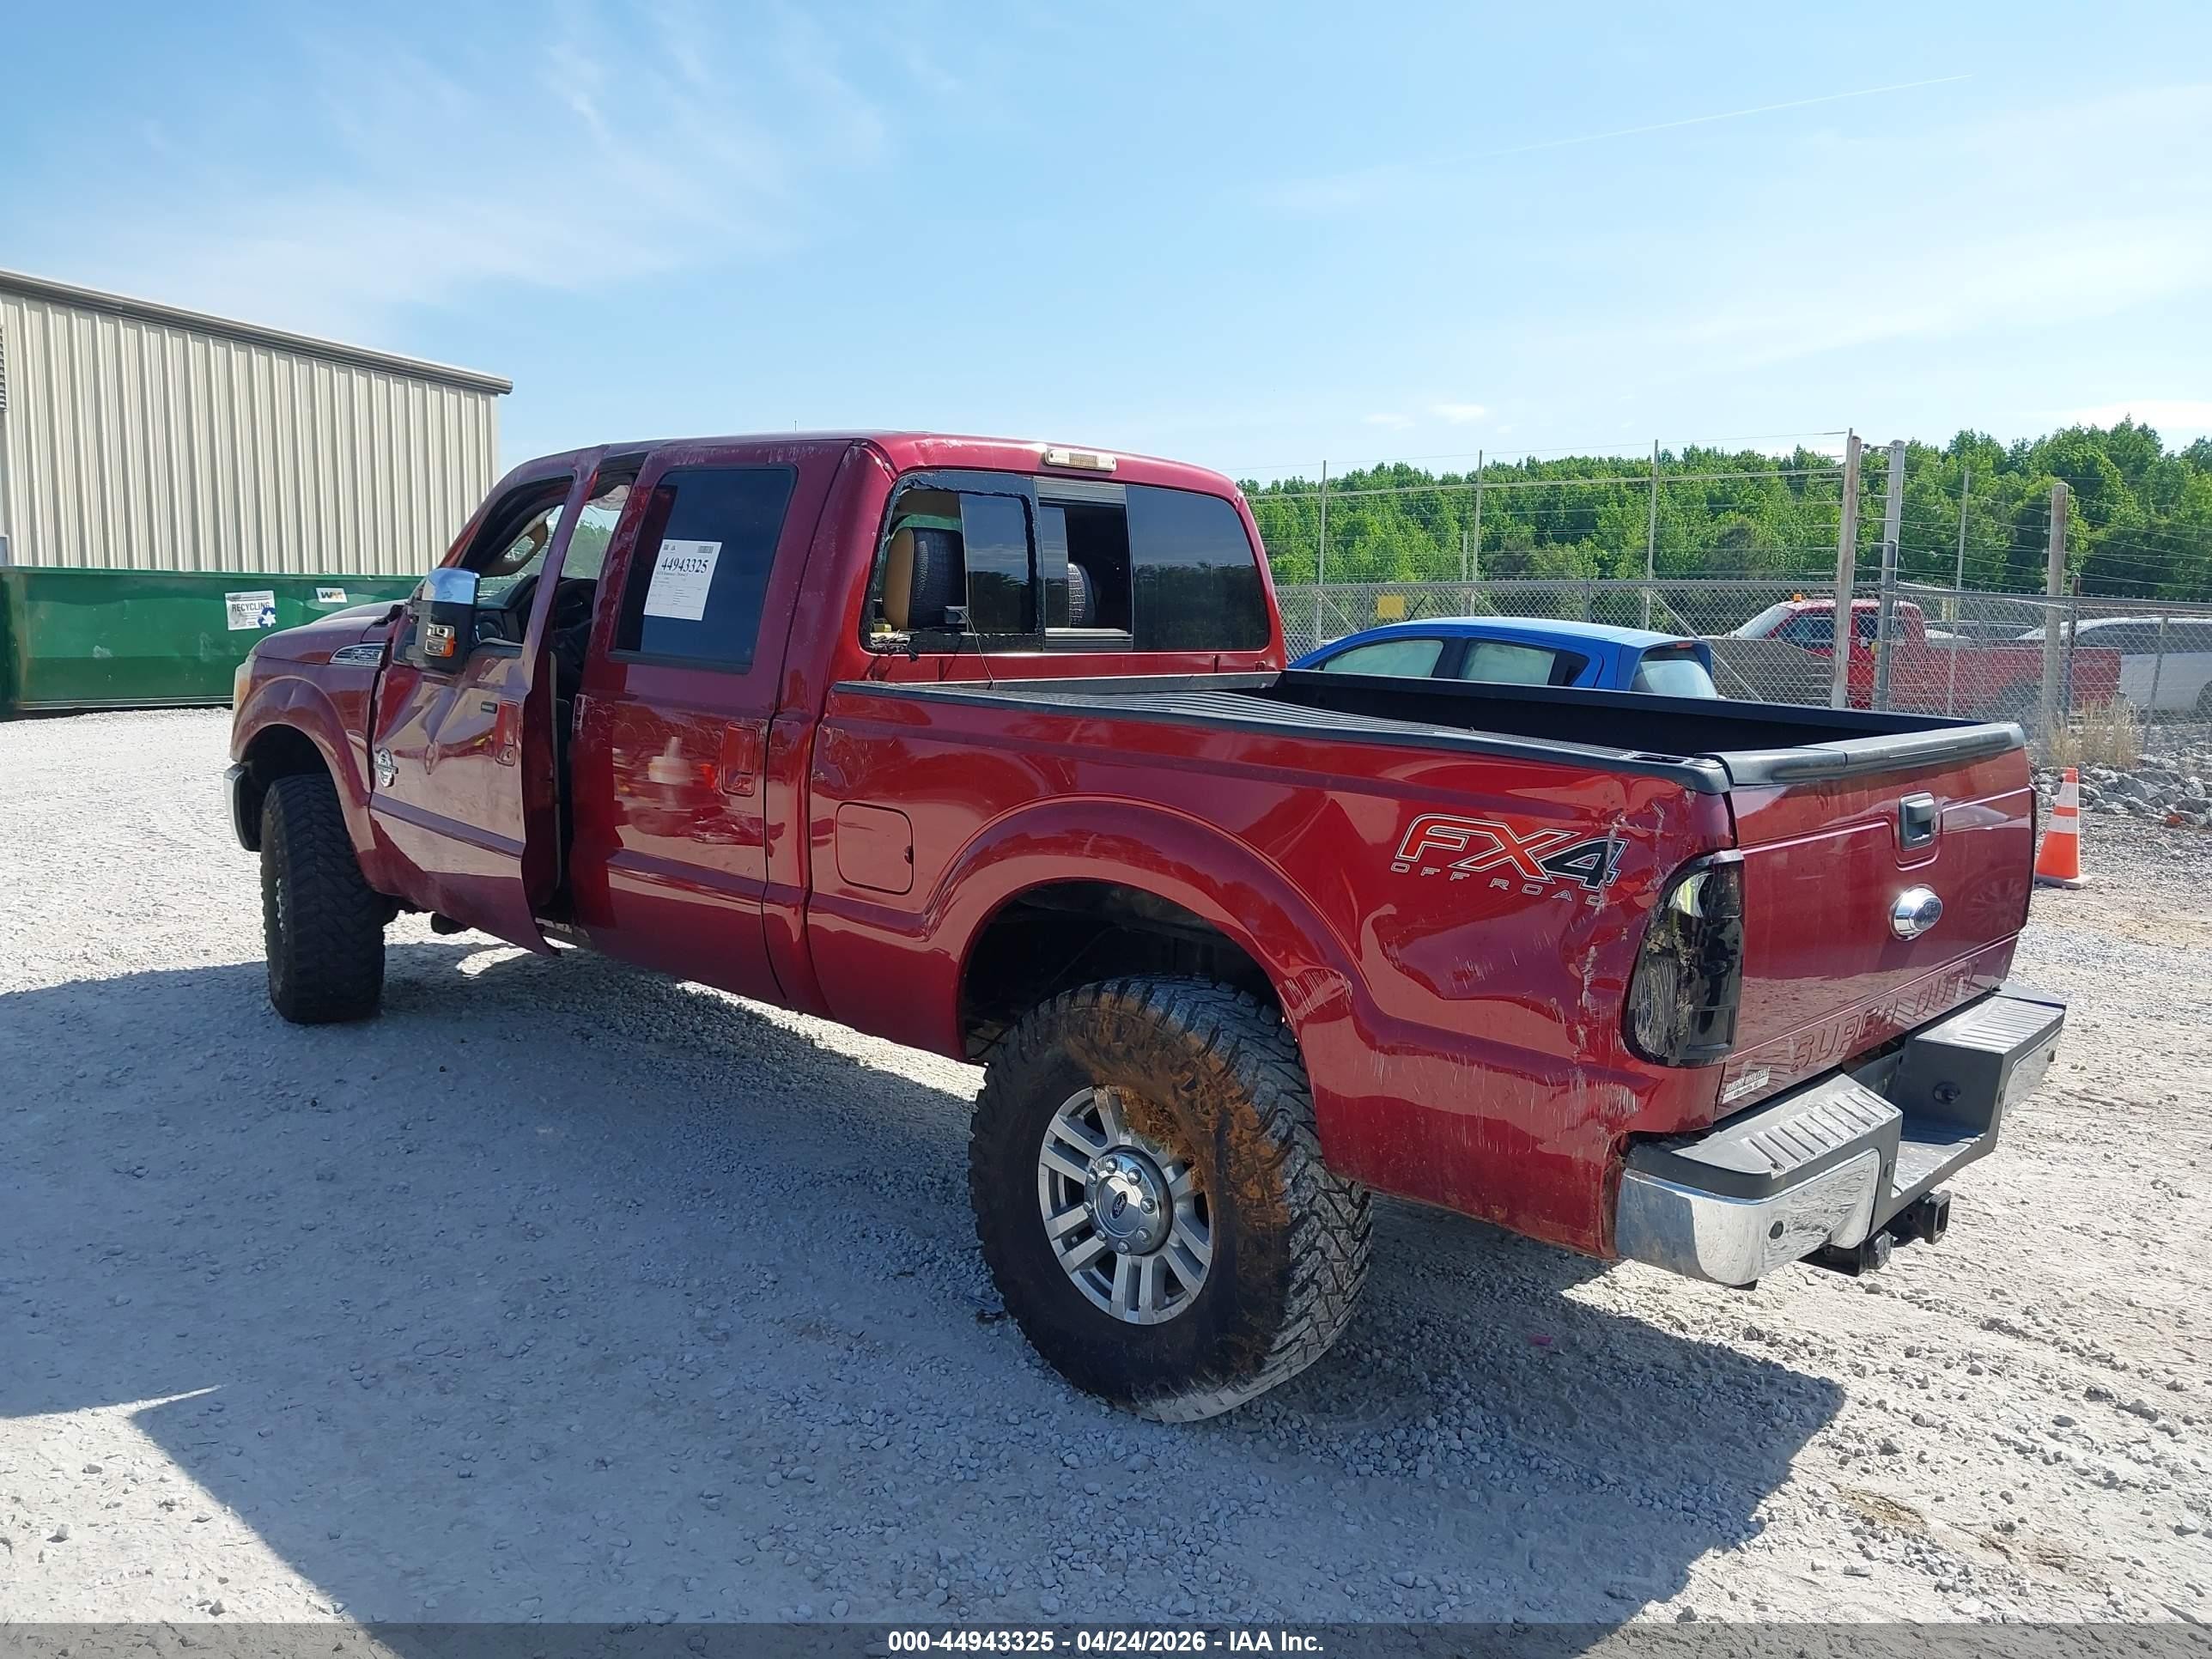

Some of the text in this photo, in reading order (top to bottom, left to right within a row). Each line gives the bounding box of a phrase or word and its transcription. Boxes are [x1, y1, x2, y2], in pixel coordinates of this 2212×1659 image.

[660, 556, 709, 574] 44943325
[231, 601, 271, 612] RECYCLING
[1395, 812, 1630, 893] FX4
[1390, 861, 1605, 908] OFF ROAD
[1790, 958, 1979, 1073] SUPER DUTY
